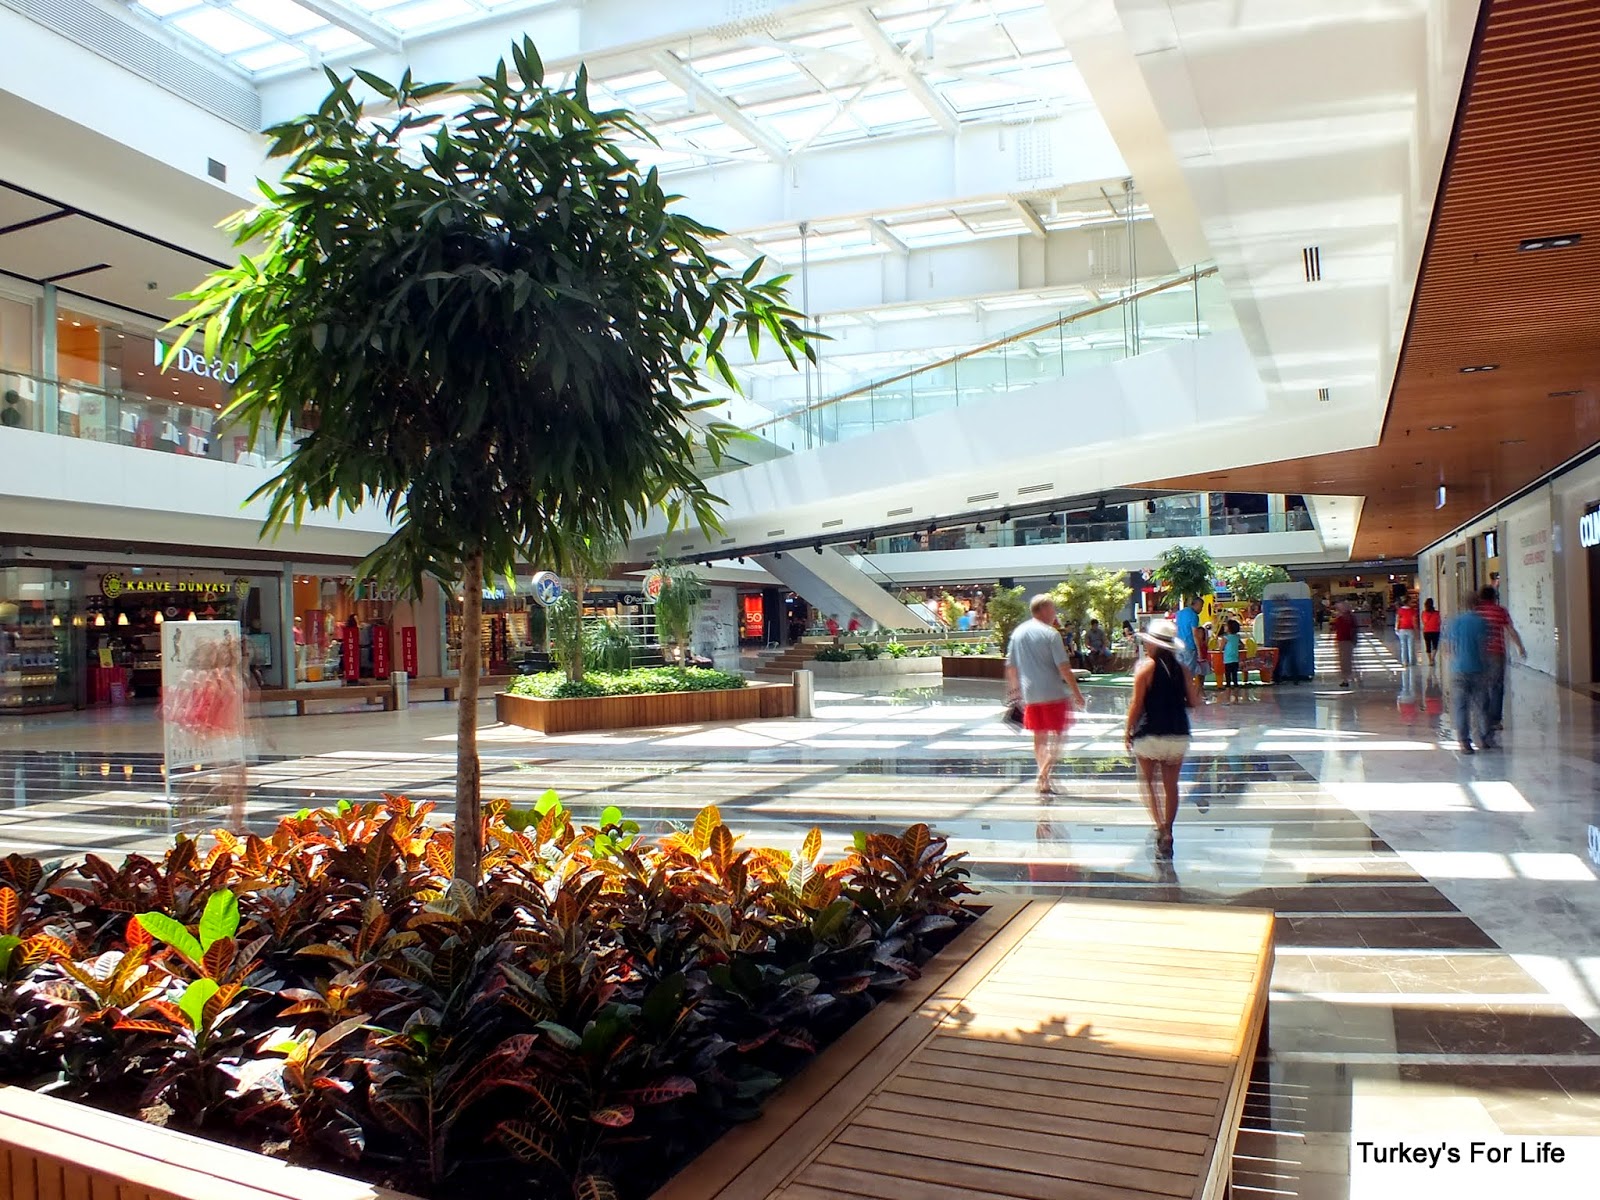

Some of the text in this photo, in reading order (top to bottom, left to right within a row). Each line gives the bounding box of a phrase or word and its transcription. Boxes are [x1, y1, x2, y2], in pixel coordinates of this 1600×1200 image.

[126, 580, 231, 593] KAHVE DÜNYASI
[746, 612, 762, 623] 50
